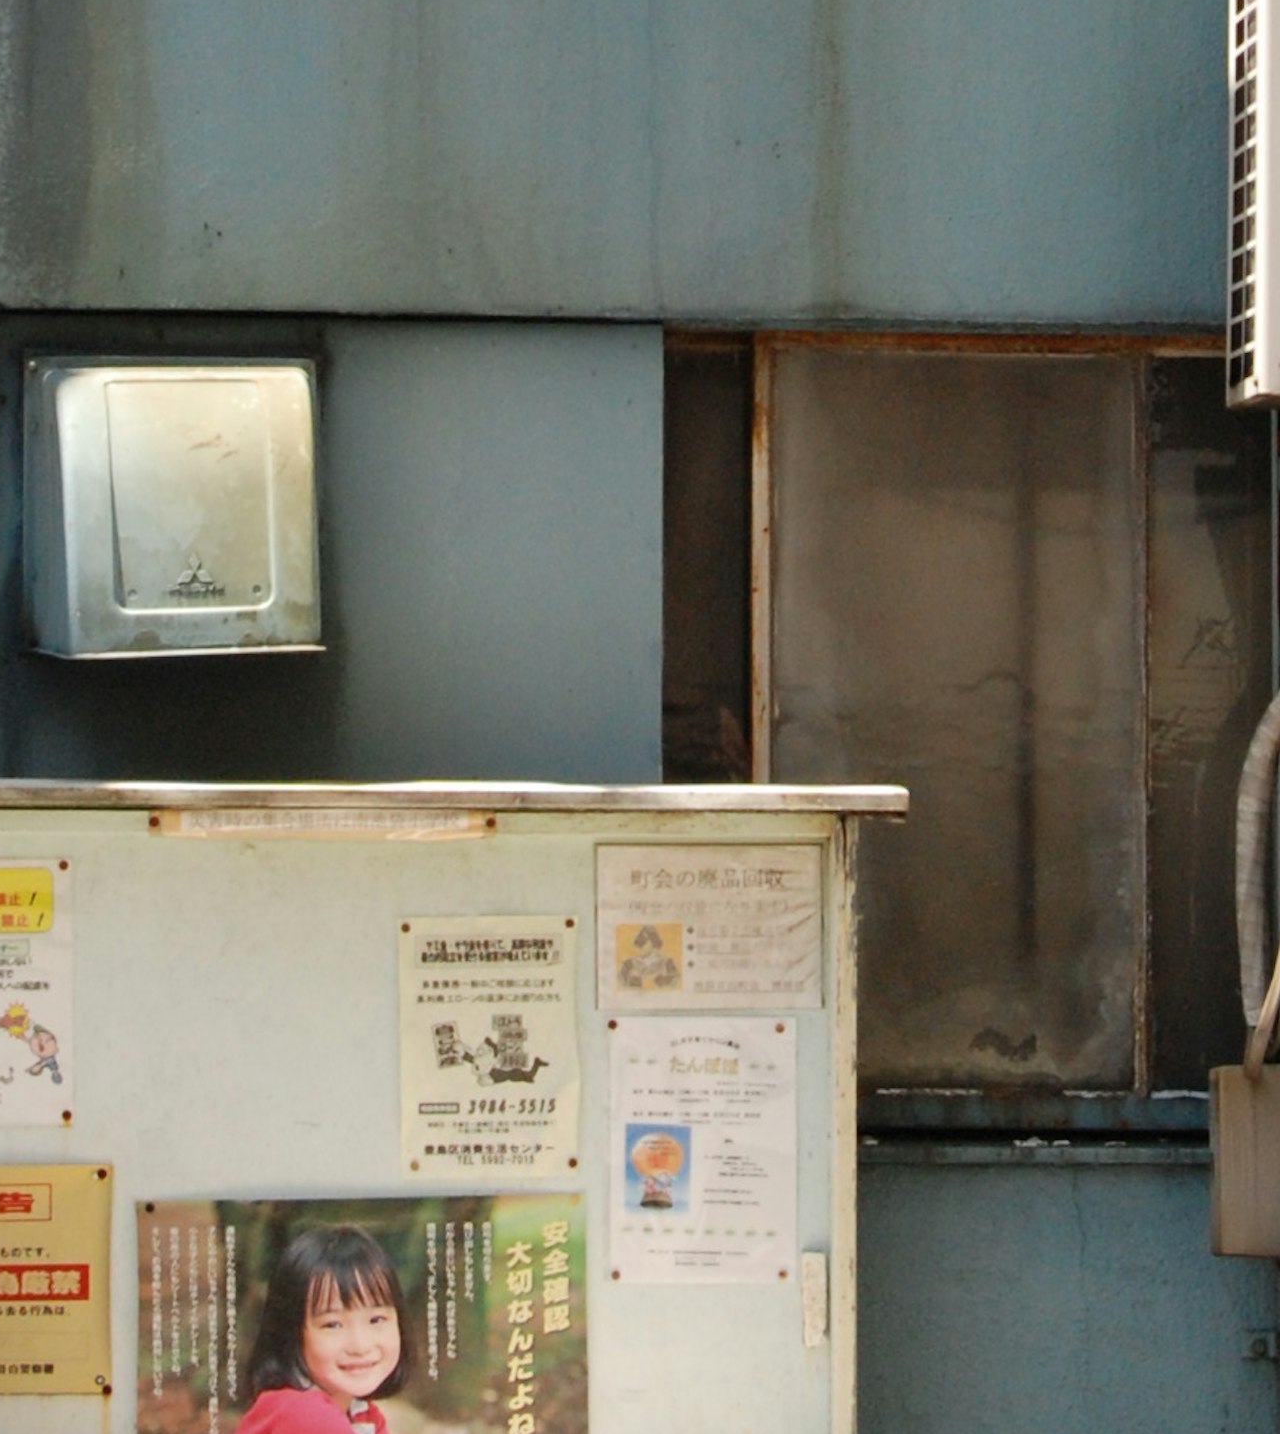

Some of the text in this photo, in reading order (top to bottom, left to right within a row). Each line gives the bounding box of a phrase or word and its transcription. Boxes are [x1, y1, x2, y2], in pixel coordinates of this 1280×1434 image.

[630, 868, 785, 891] 町会の廃品回収
[467, 1098, 557, 1115] 3984-5515
[541, 1220, 572, 1335] 安全確認
